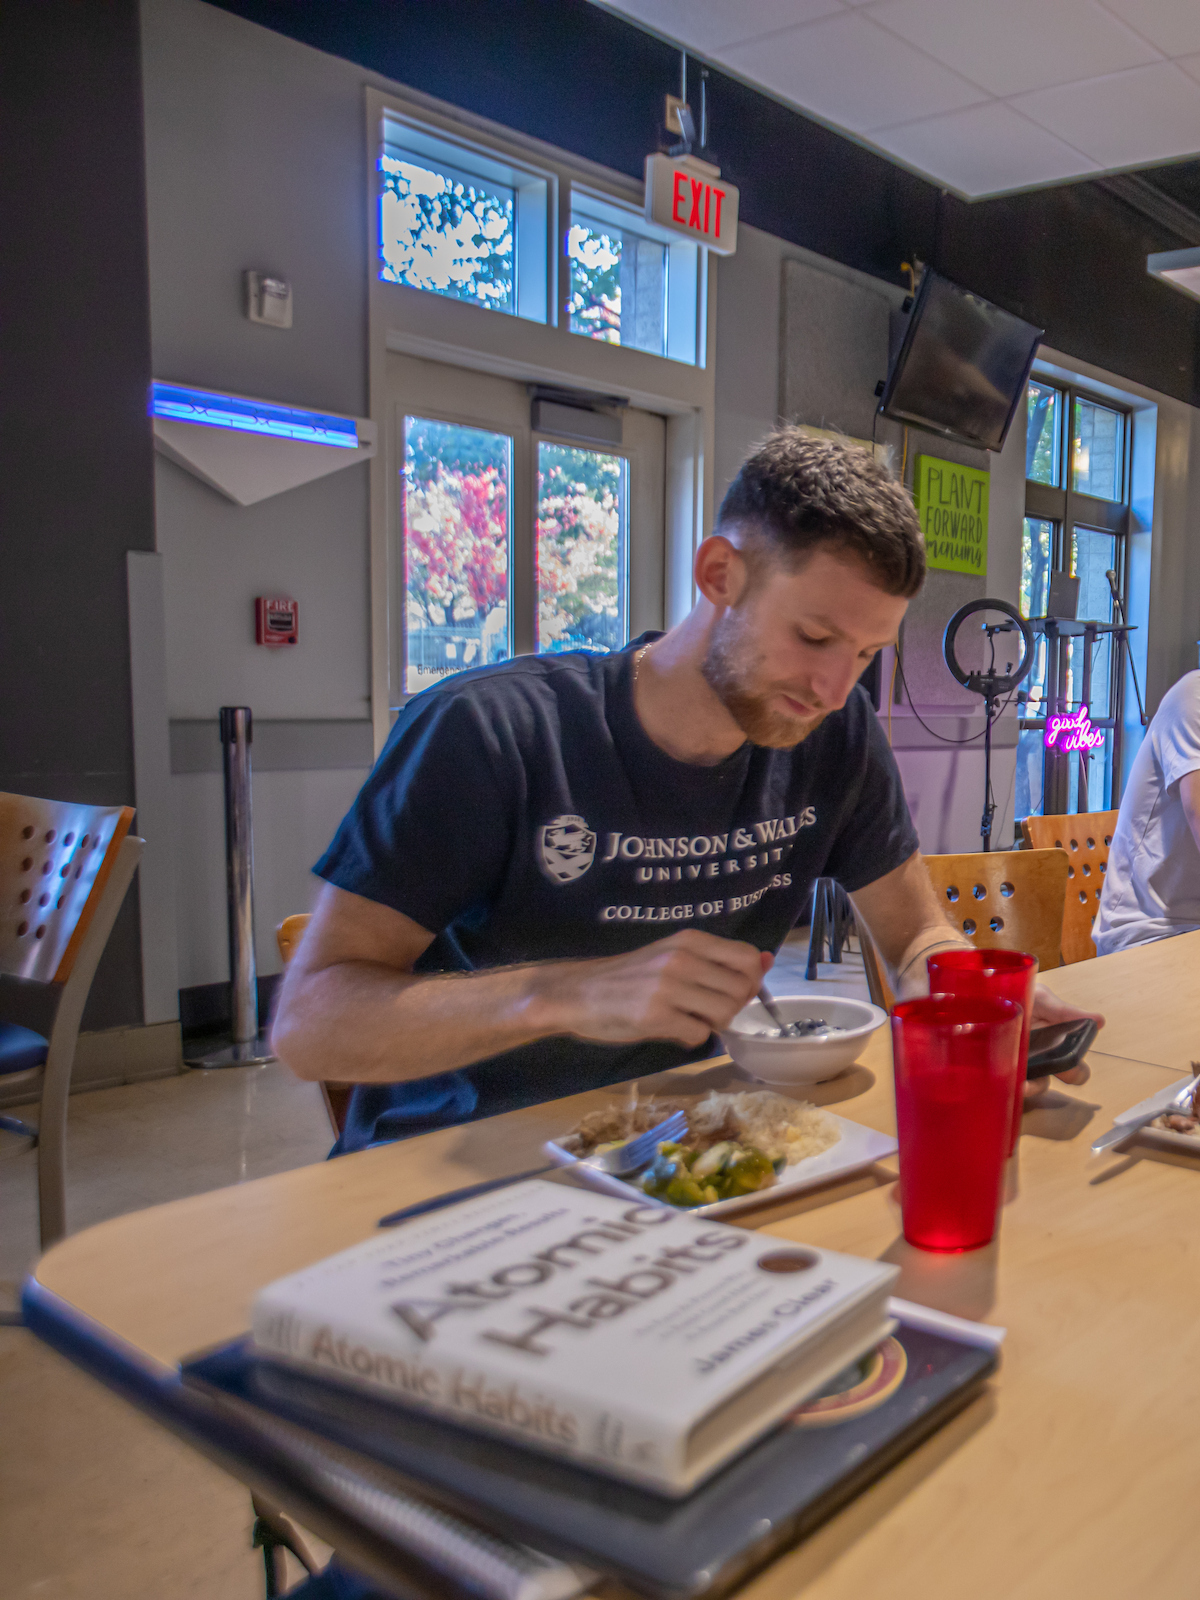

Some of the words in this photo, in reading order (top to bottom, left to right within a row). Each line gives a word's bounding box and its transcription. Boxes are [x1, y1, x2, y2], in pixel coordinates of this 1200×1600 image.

[672, 170, 726, 238] EXIT
[927, 466, 986, 515] PLANT
[926, 506, 983, 544] FORWARD
[266, 600, 294, 611] FIRE
[1047, 705, 1089, 745] good
[1065, 718, 1105, 750] vibes
[601, 832, 729, 862] JOHNSON
[734, 828, 757, 849] &
[640, 844, 794, 882] UNIVERSIT
[602, 904, 695, 921] COLLEGE
[700, 900, 724, 917] OF
[731, 873, 793, 912] BUSISS
[390, 1205, 680, 1343] Atomic
[480, 1230, 748, 1356] Habits
[694, 1320, 780, 1374] James
[773, 1277, 840, 1318] Clear
[311, 1322, 443, 1398] Atomic
[442, 1364, 580, 1446] Habits
